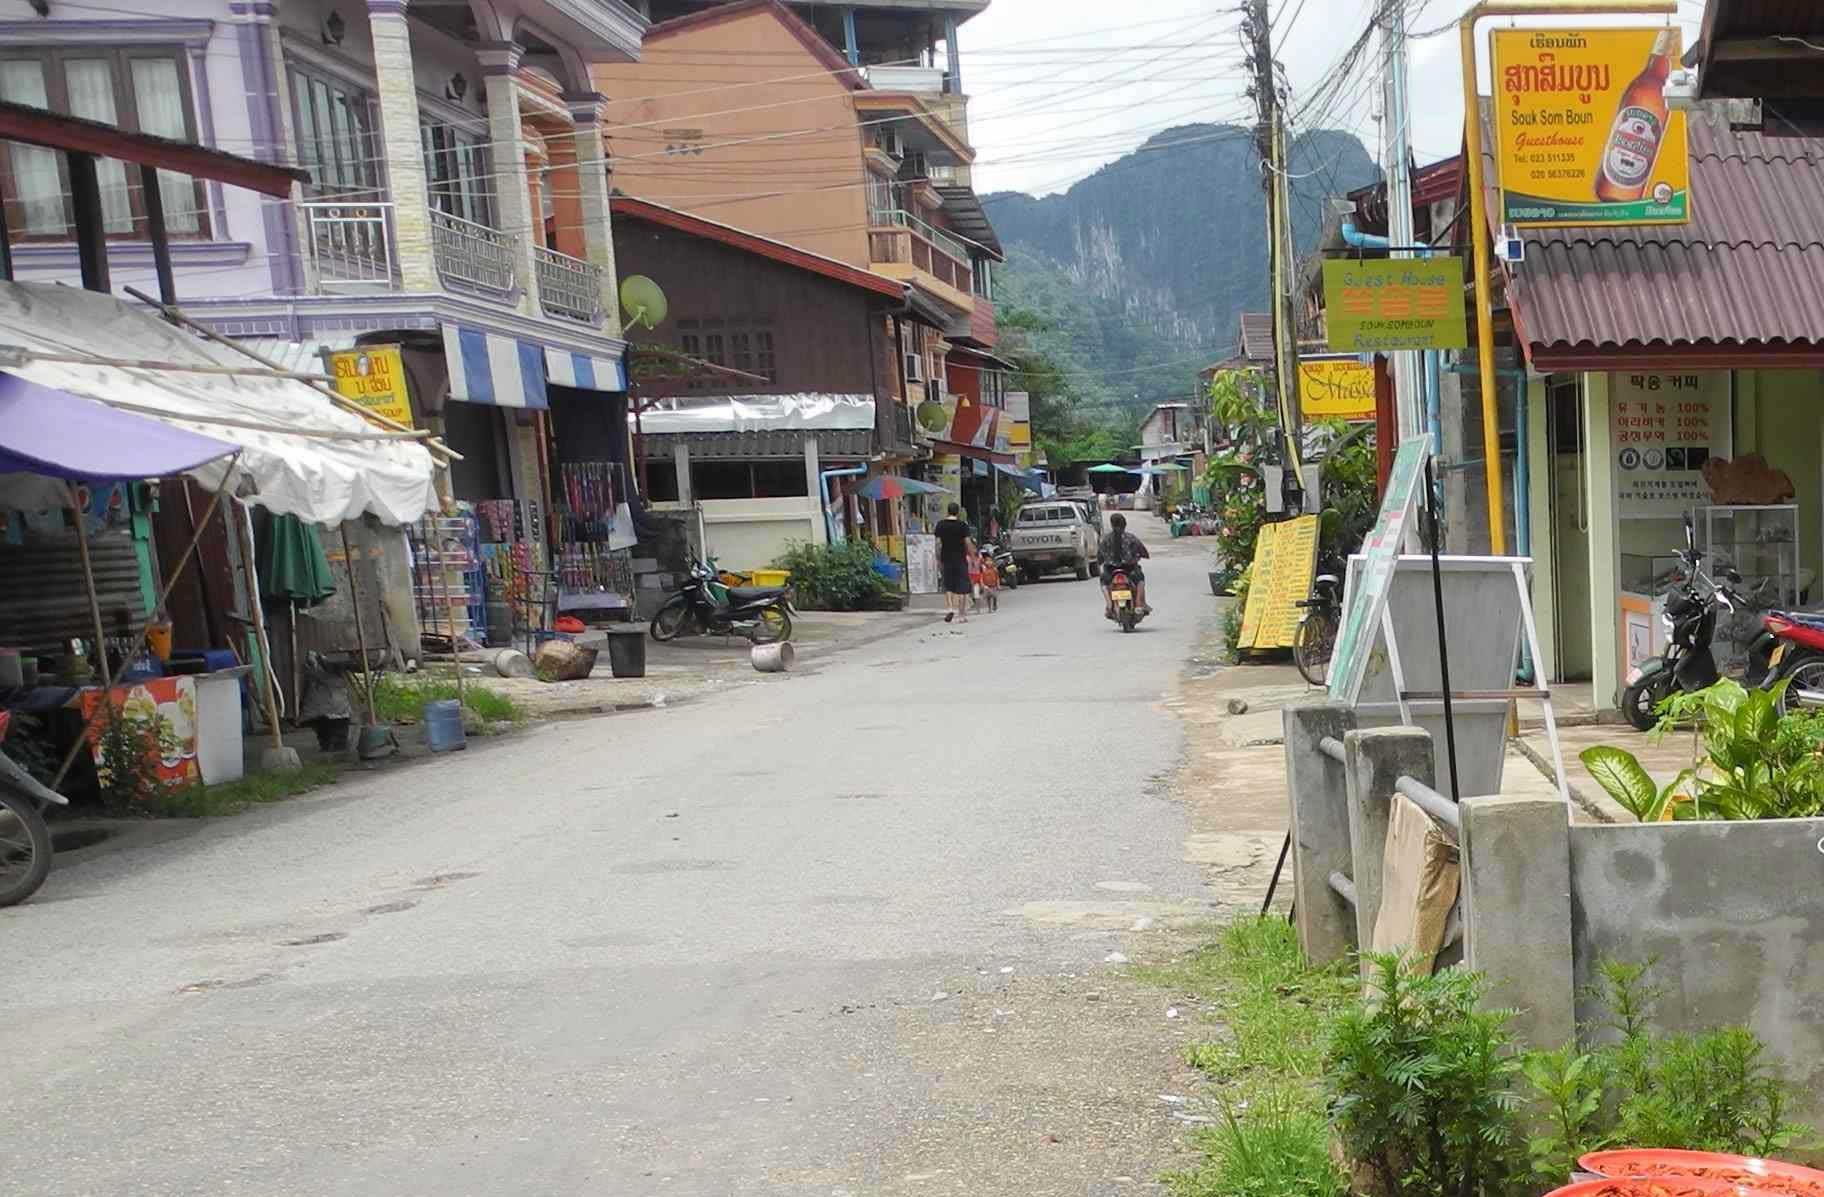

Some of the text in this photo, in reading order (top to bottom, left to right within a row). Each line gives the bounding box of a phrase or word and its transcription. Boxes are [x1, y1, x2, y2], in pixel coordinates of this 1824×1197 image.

[1511, 109, 1594, 126] Souk Som Boun
[1514, 131, 1585, 151] Guesthouse
[1678, 402, 1711, 414] 100%
[1677, 416, 1710, 428] 100%
[1677, 430, 1710, 441] 100%
[1020, 535, 1063, 545] TOYOTA
